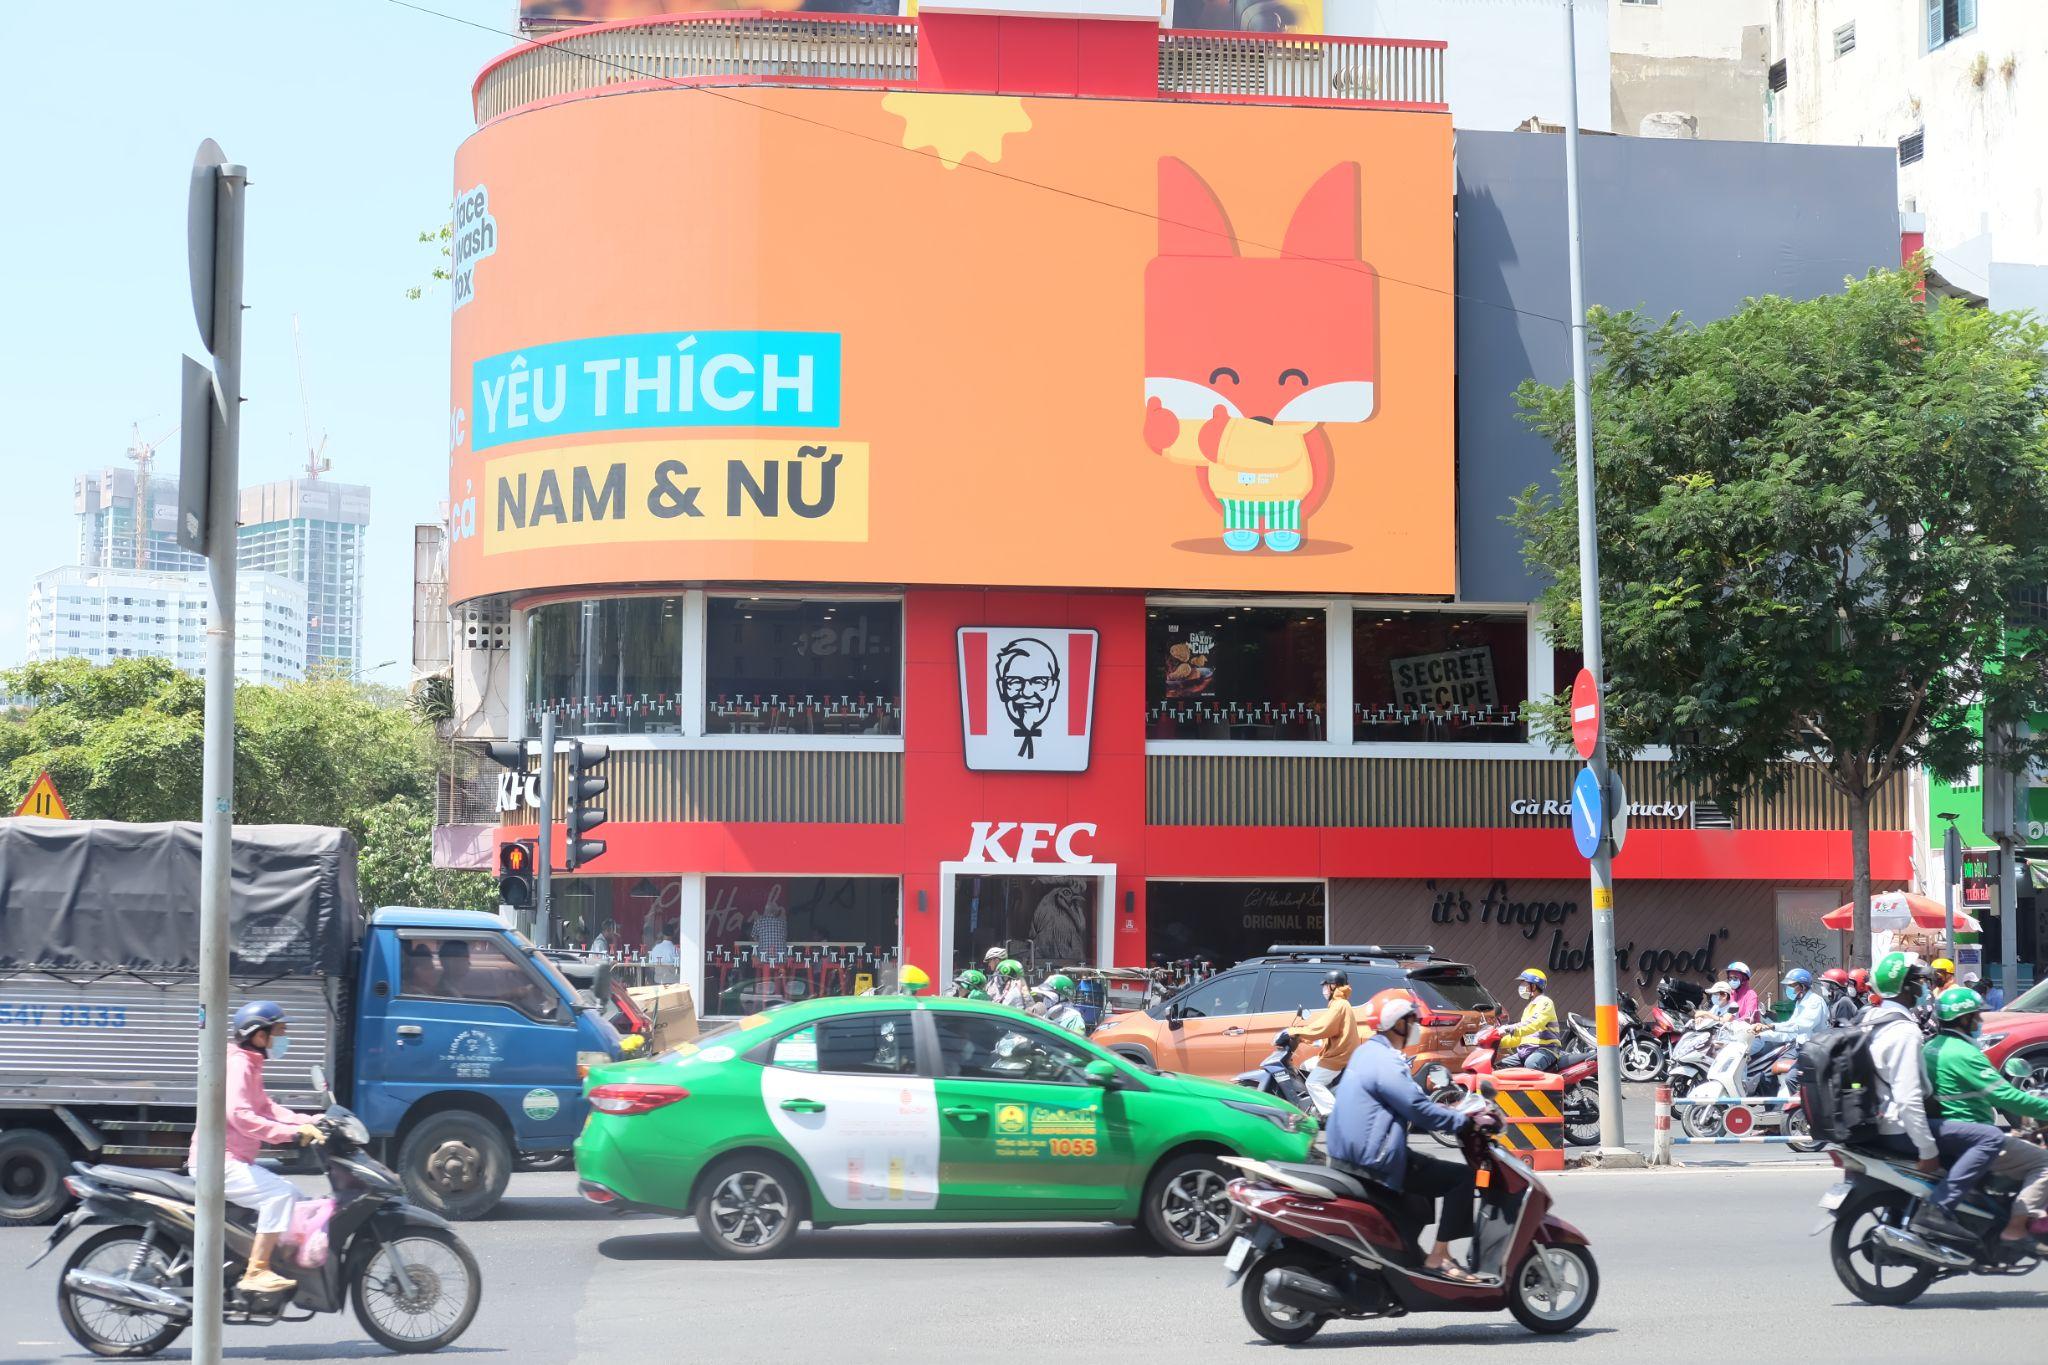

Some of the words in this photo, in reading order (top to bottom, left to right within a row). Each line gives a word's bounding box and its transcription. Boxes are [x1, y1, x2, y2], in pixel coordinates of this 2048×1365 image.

[481, 354, 566, 434] YÊU
[583, 334, 814, 417] THÍCH
[497, 462, 627, 532] NAM
[646, 459, 705, 520] &
[726, 445, 844, 519] NỮ
[1398, 652, 1486, 688] SECRET
[1402, 681, 1492, 711] RECIPE
[495, 767, 541, 812] KFC
[1510, 799, 1541, 815] Gà
[1542, 799, 1572, 815] Rá
[1626, 800, 1688, 820] ntucky
[963, 821, 1097, 864] KFC
[1243, 914, 1303, 929] ORIGINAL
[1307, 915, 1326, 929] RE
[1480, 880, 1578, 940] finger
[1049, 1138, 1097, 1156] 1055
